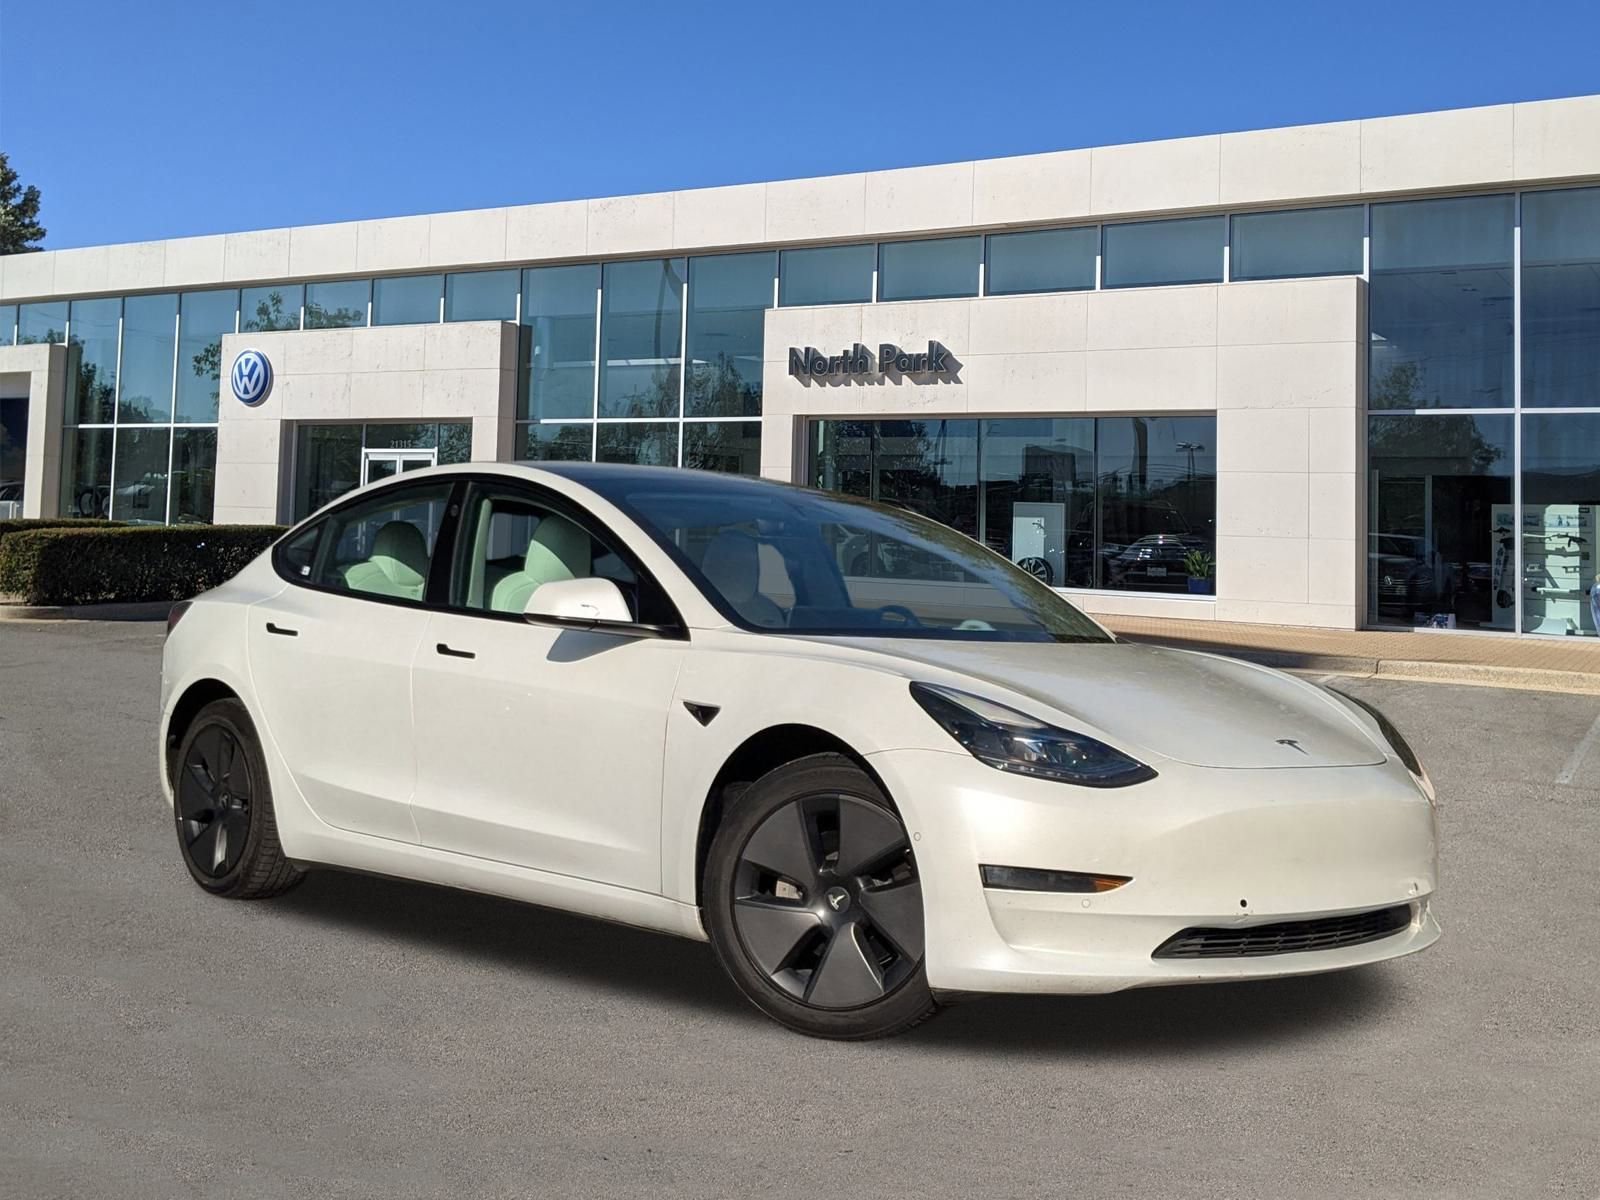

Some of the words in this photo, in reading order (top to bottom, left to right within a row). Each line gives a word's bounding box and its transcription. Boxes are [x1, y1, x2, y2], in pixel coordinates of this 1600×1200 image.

[232, 351, 267, 402] VW
[788, 342, 871, 376] North
[878, 339, 950, 373] Park
